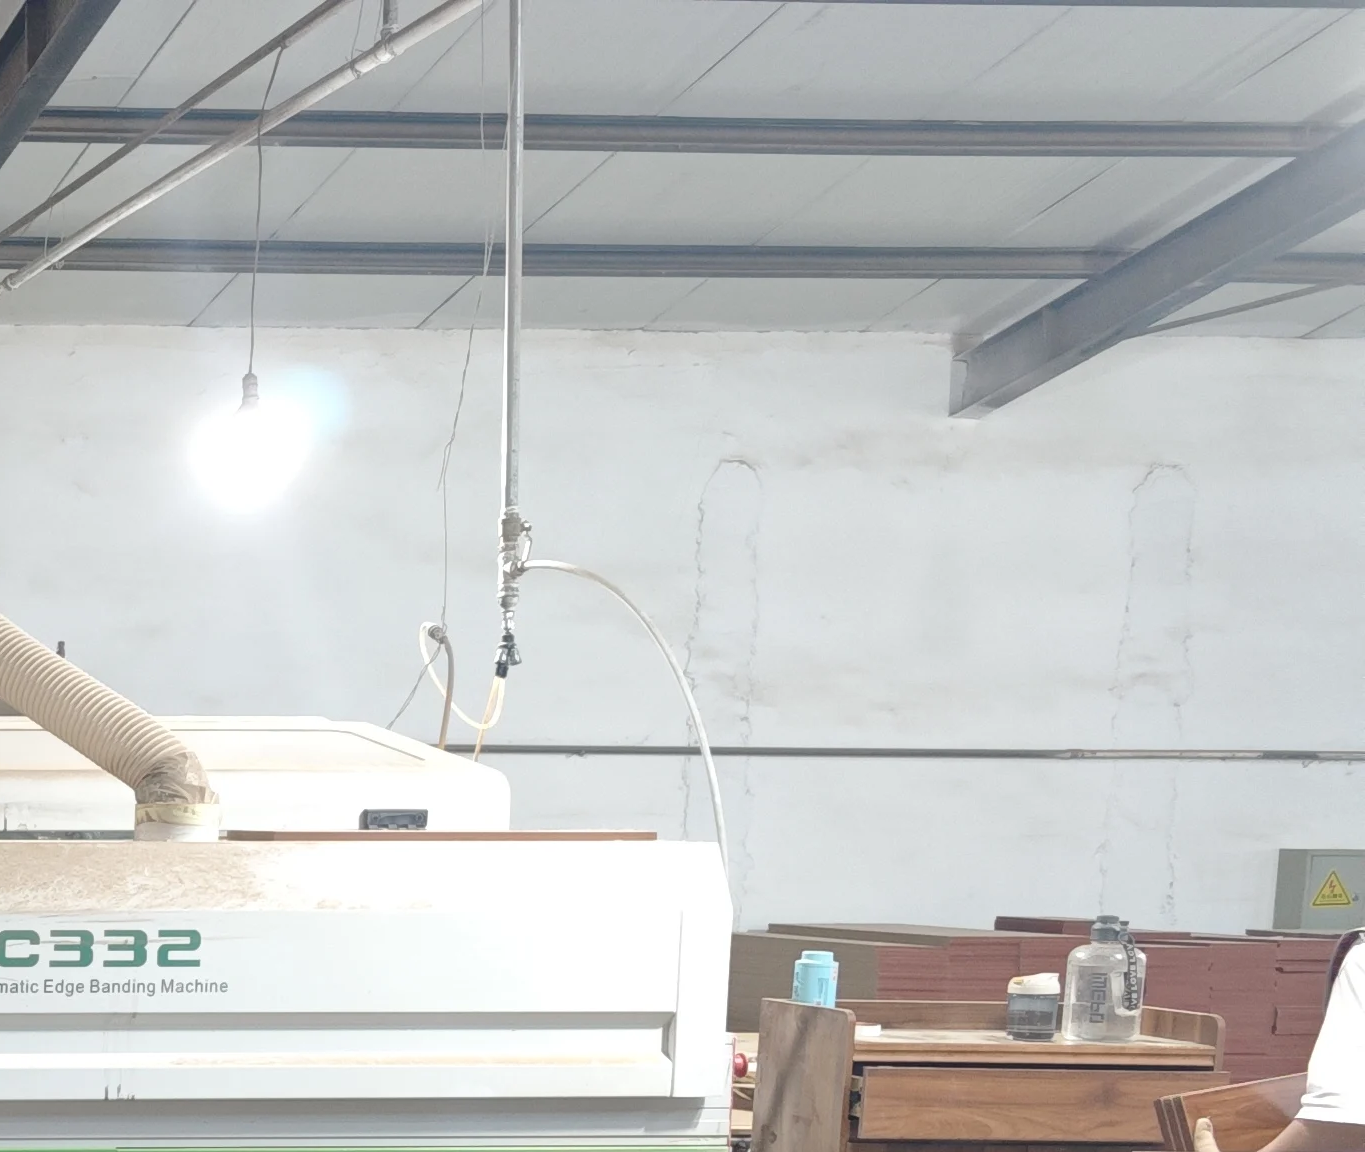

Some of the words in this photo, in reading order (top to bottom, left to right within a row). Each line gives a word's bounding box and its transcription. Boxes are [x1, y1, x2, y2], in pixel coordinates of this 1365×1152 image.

[43, 979, 85, 997] Edge
[89, 979, 156, 997] Banding
[161, 979, 228, 994] Machine
